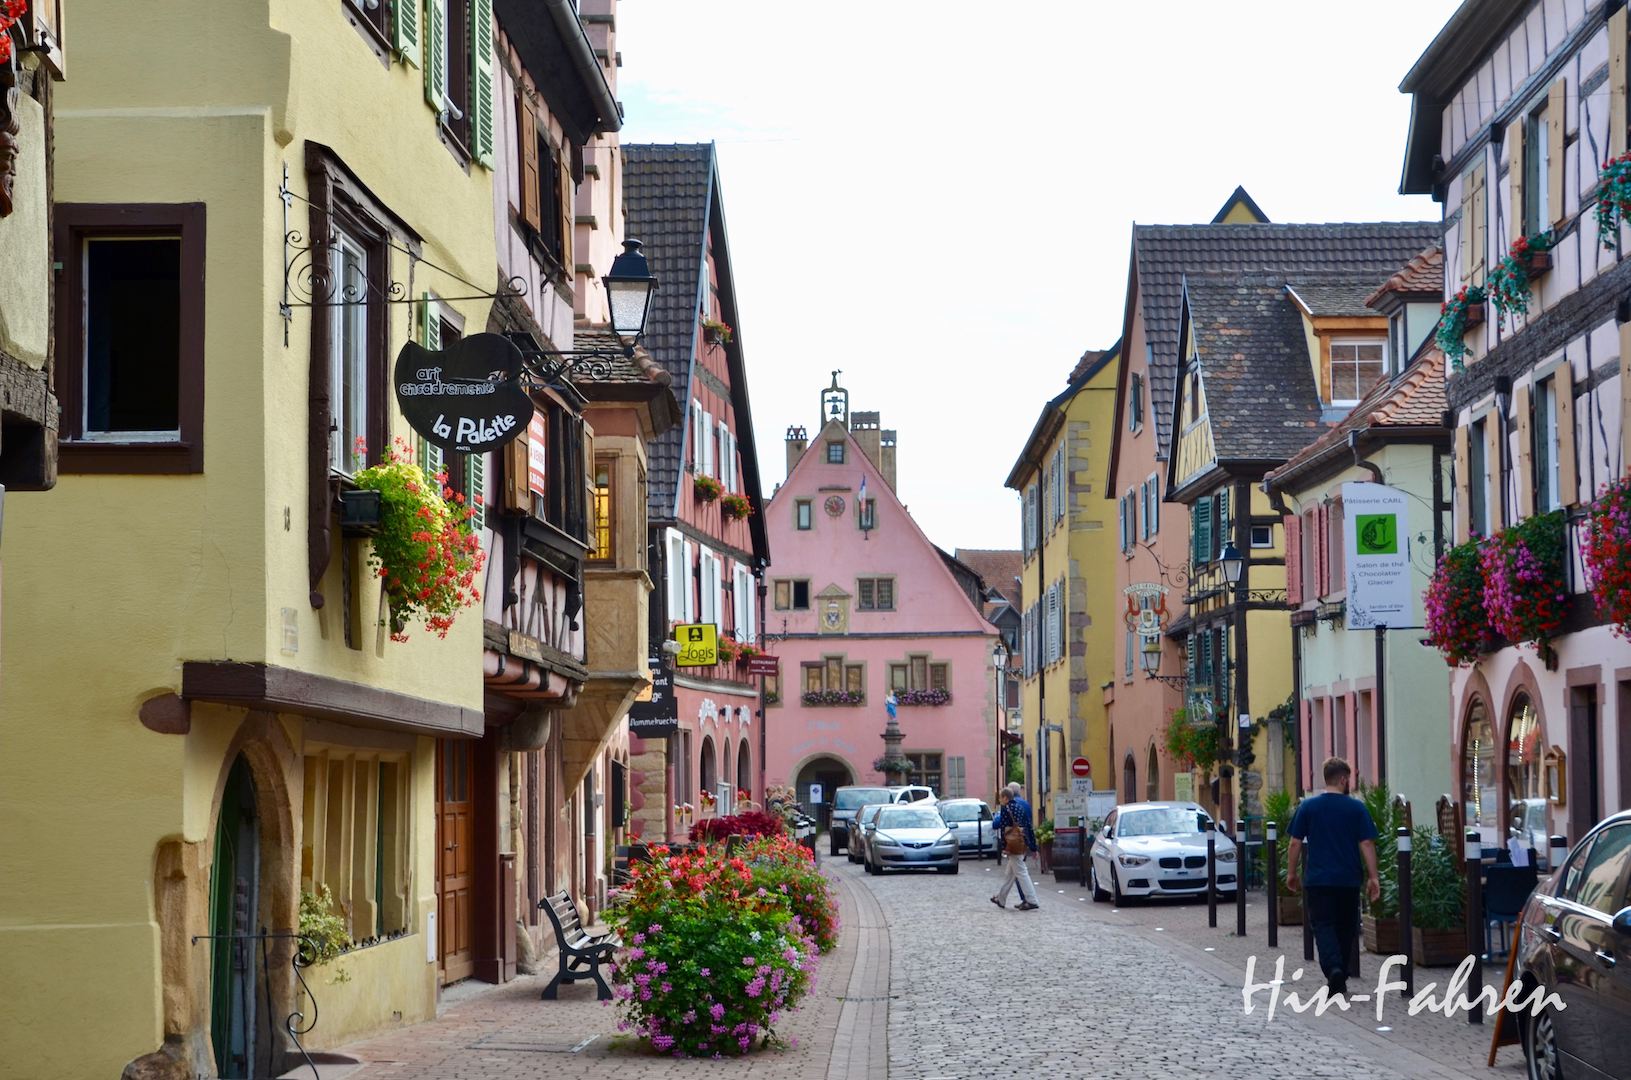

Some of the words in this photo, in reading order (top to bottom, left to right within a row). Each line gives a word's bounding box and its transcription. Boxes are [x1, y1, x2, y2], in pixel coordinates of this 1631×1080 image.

[416, 366, 442, 381] art
[399, 380, 496, 396] encadrements
[432, 414, 452, 439] la
[455, 414, 517, 444] Palette
[678, 642, 715, 663] Logis
